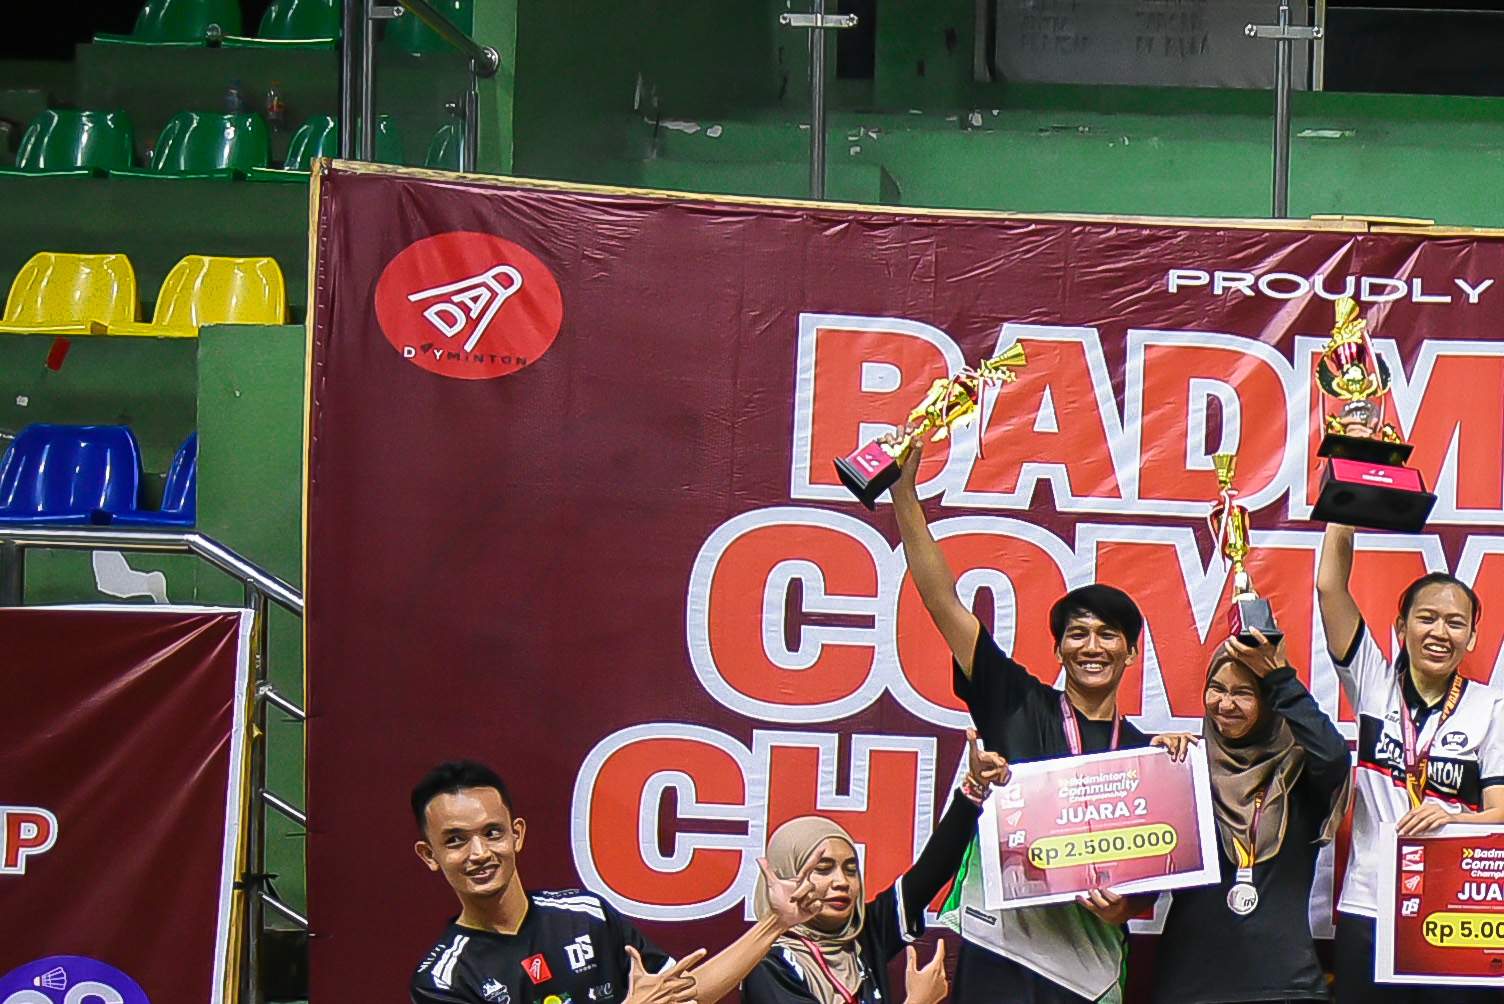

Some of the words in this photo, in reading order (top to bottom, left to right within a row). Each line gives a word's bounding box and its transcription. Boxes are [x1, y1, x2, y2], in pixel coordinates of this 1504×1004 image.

[1166, 269, 1494, 304] PROUDLY
[1058, 778, 1140, 798] Community
[1056, 803, 1131, 825] JUARA
[1133, 798, 1148, 815] 2
[1031, 846, 1059, 866] Rp
[1064, 829, 1175, 858] 2.500.000
[1425, 920, 1454, 943] Rp
